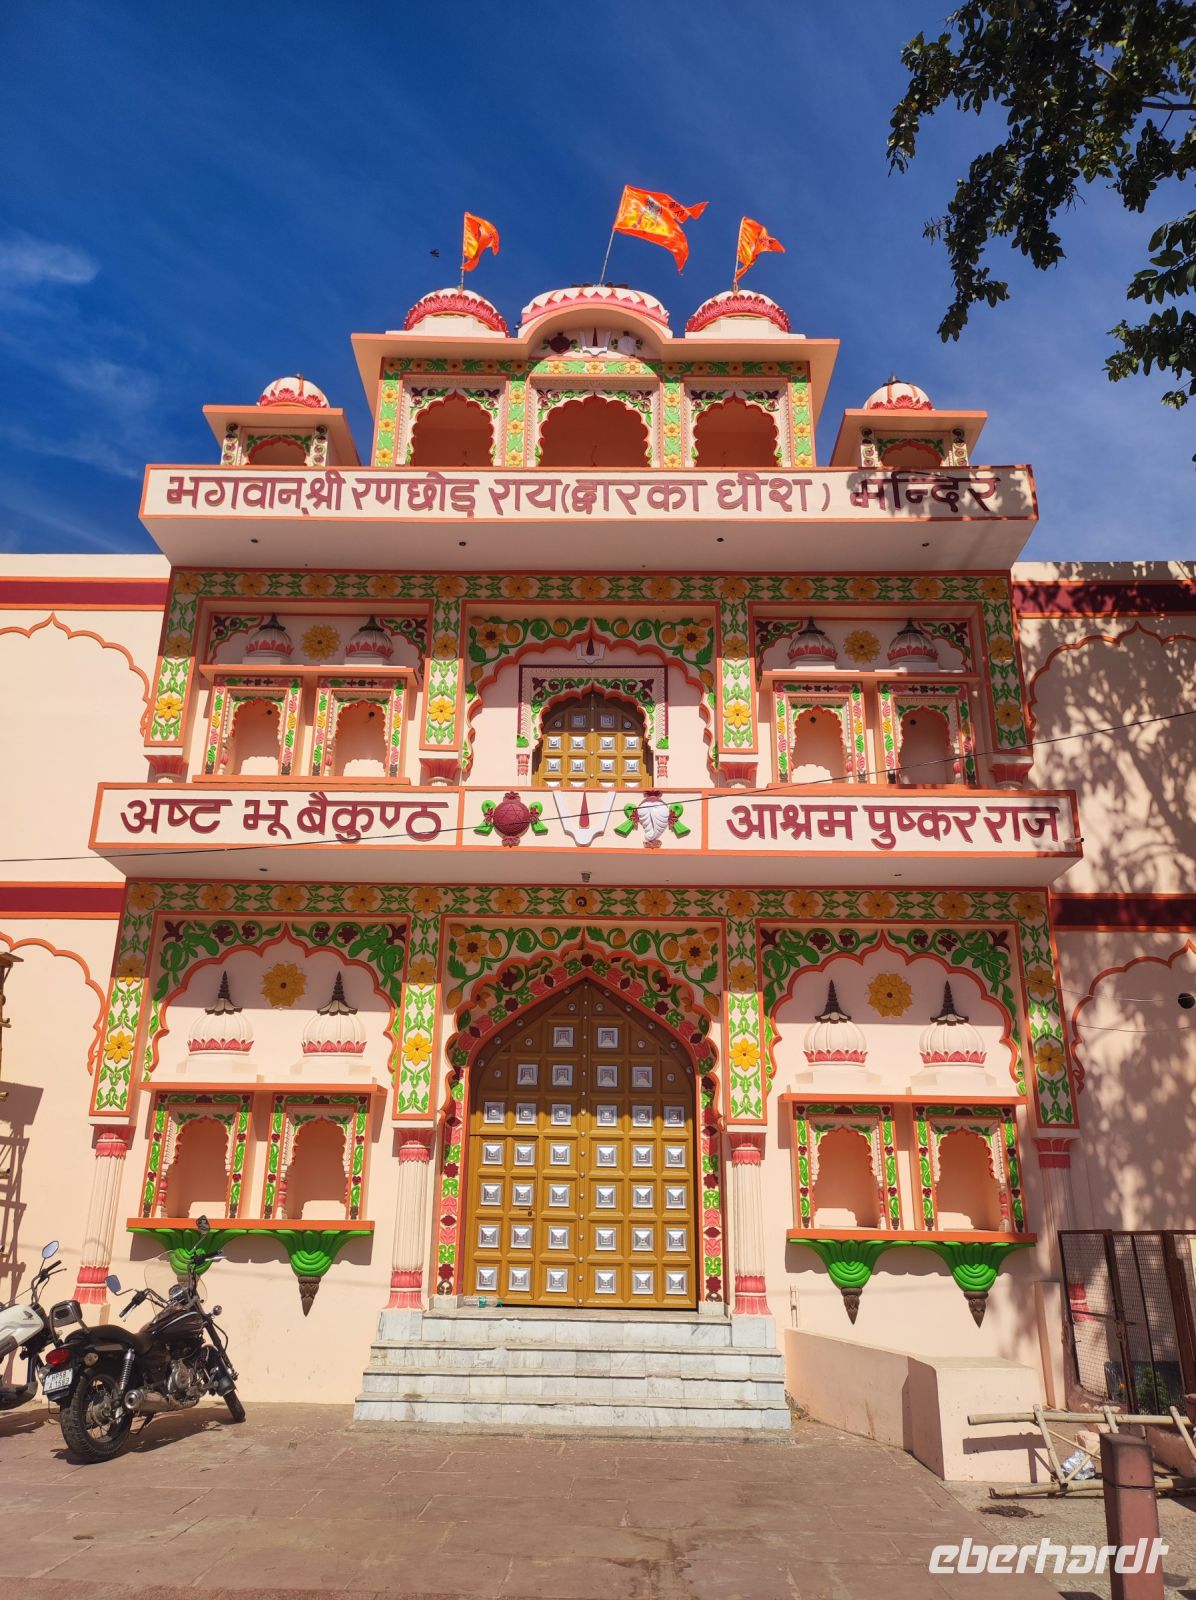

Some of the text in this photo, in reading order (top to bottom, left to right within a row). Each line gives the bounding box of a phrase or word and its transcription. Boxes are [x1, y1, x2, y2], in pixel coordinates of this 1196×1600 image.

[306, 469, 347, 511] श्री
[850, 471, 1001, 513] मन्दिर
[120, 798, 233, 834] अष्ट
[296, 791, 449, 845] बैकुण्ठ
[726, 804, 859, 841] आश्रम
[862, 805, 981, 850] पुष्कर
